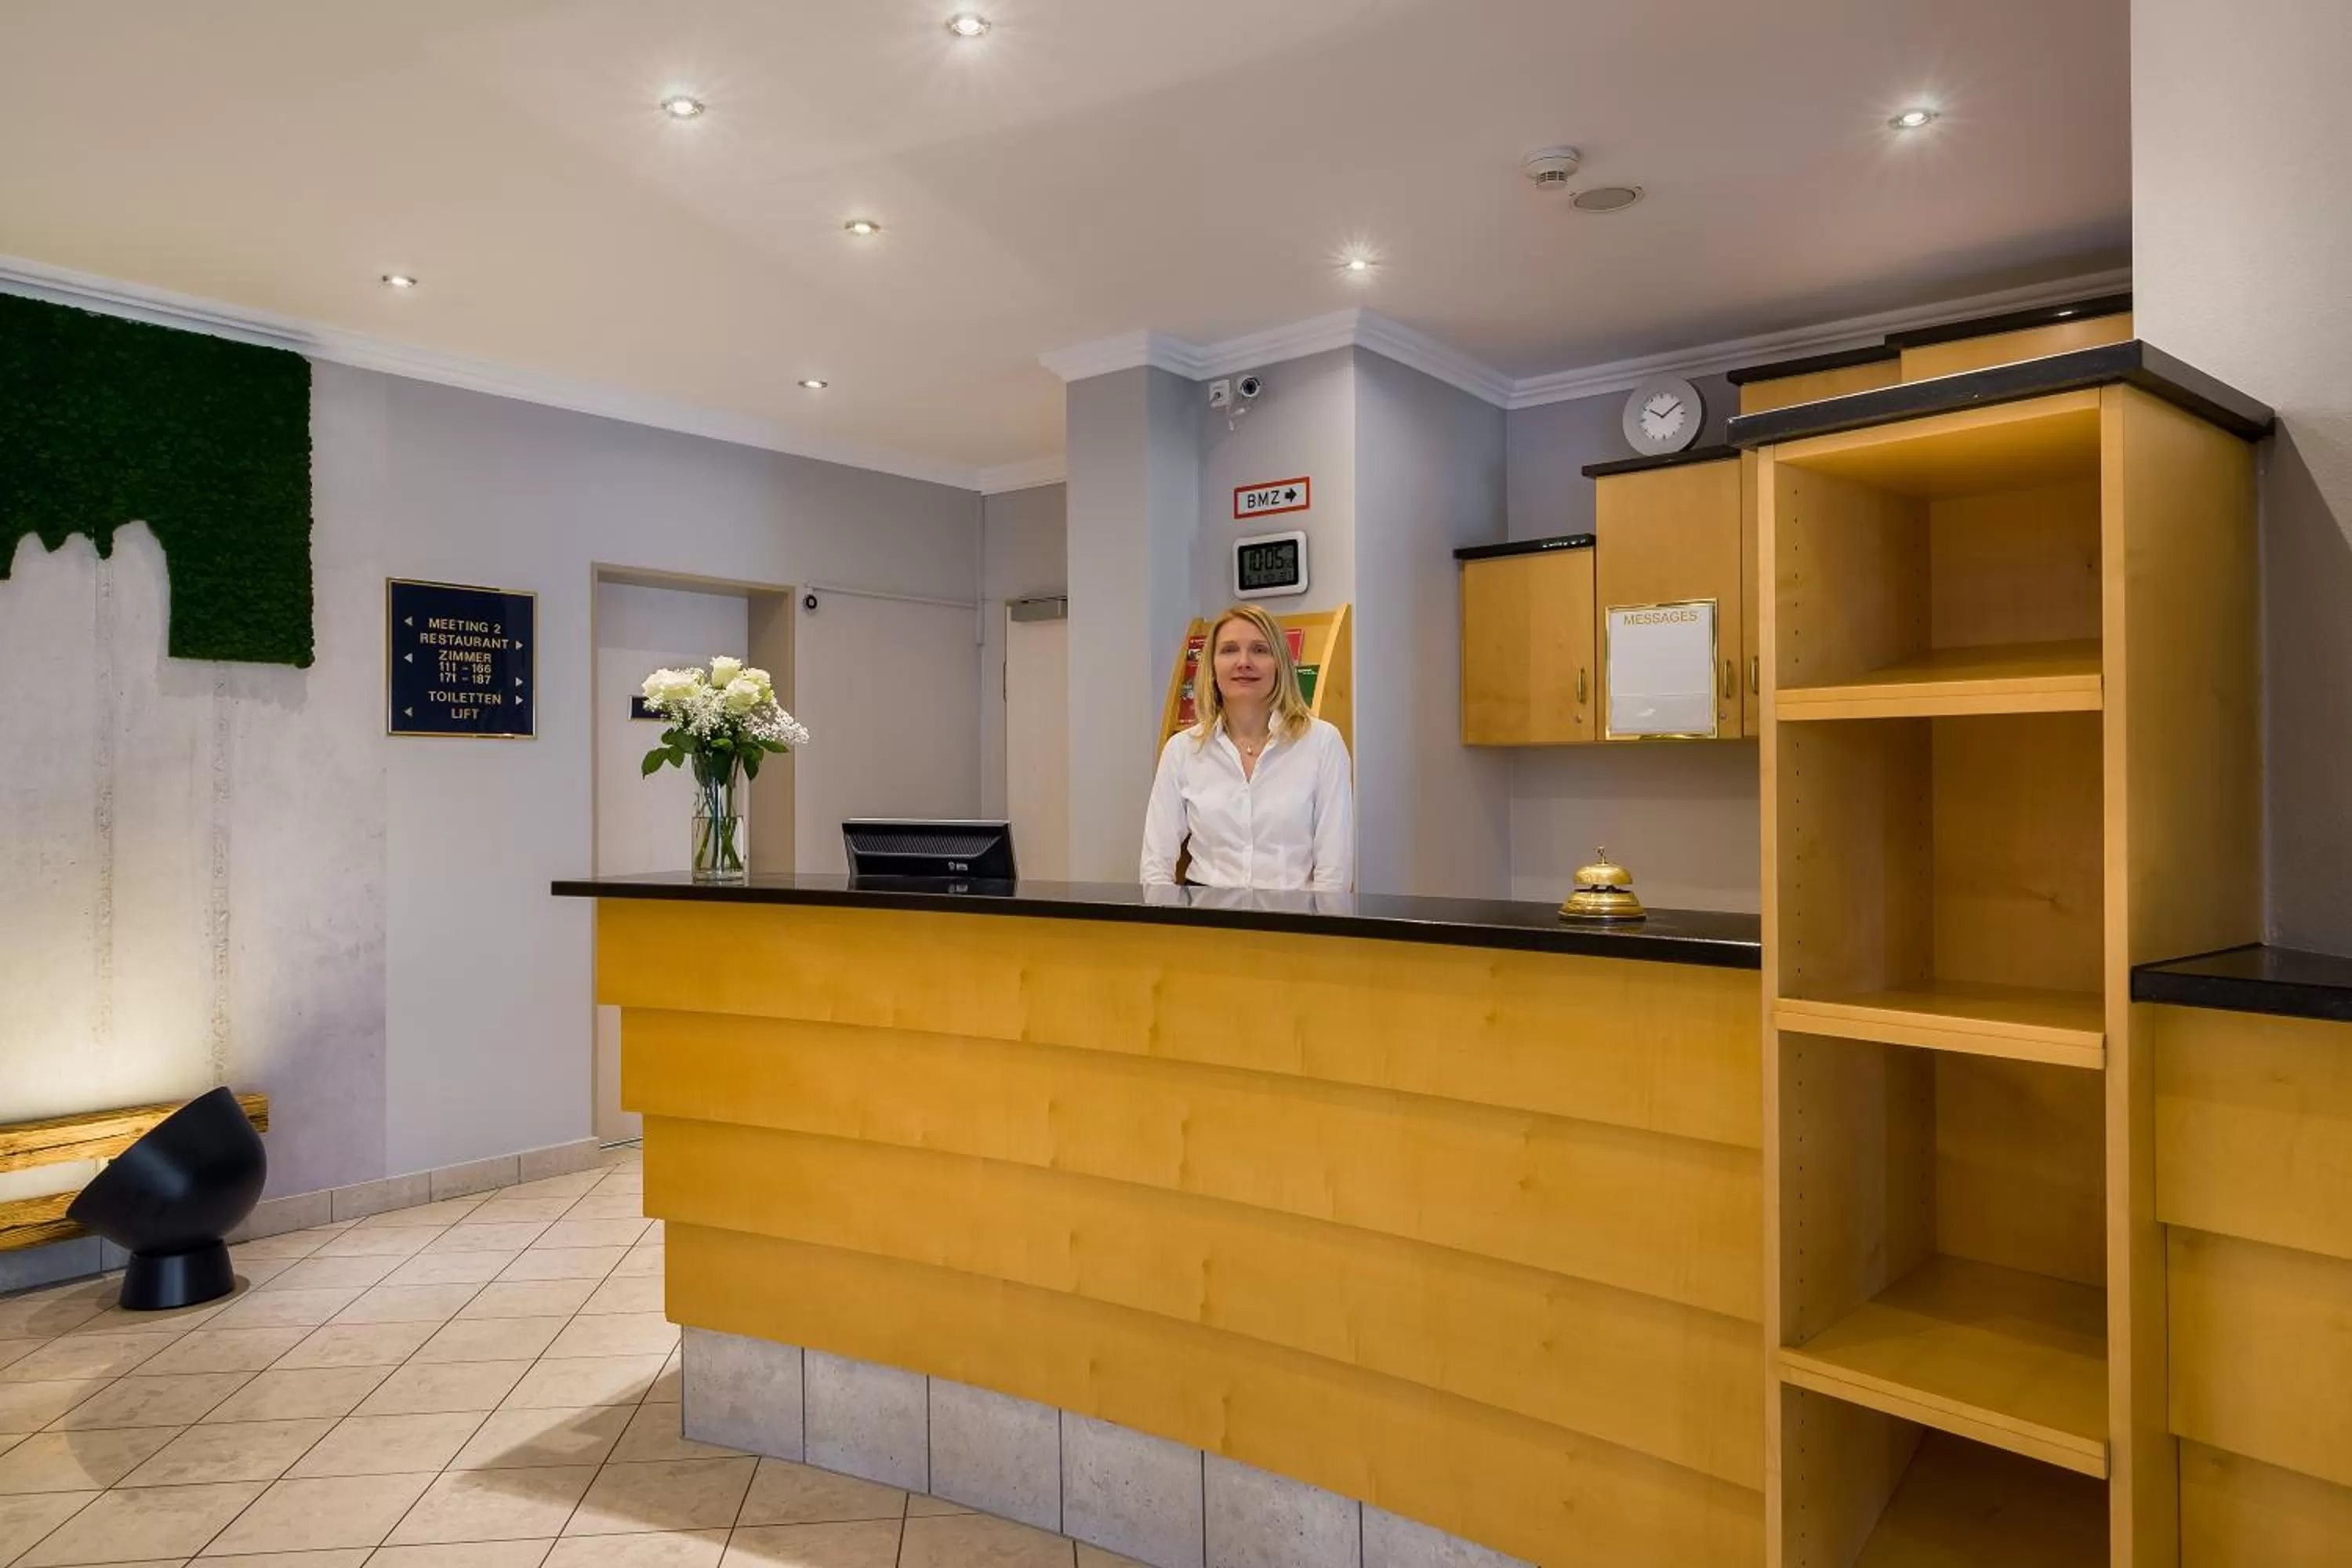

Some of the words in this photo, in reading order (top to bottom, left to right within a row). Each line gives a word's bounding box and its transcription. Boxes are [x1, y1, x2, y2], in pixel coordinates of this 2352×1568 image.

[1247, 490, 1279, 508] BMZ
[1624, 611, 1698, 625] MESSAGES
[429, 617, 488, 633] MEETING
[493, 623, 501, 633] 2
[420, 633, 508, 649] RESTAURANT
[439, 650, 492, 662] ZIMMER
[439, 661, 456, 672] 111
[472, 662, 492, 673] 166
[439, 672, 456, 683] 171
[472, 674, 492, 684] 187
[428, 691, 501, 704] TOILETTEN
[451, 708, 480, 719] LIFT
